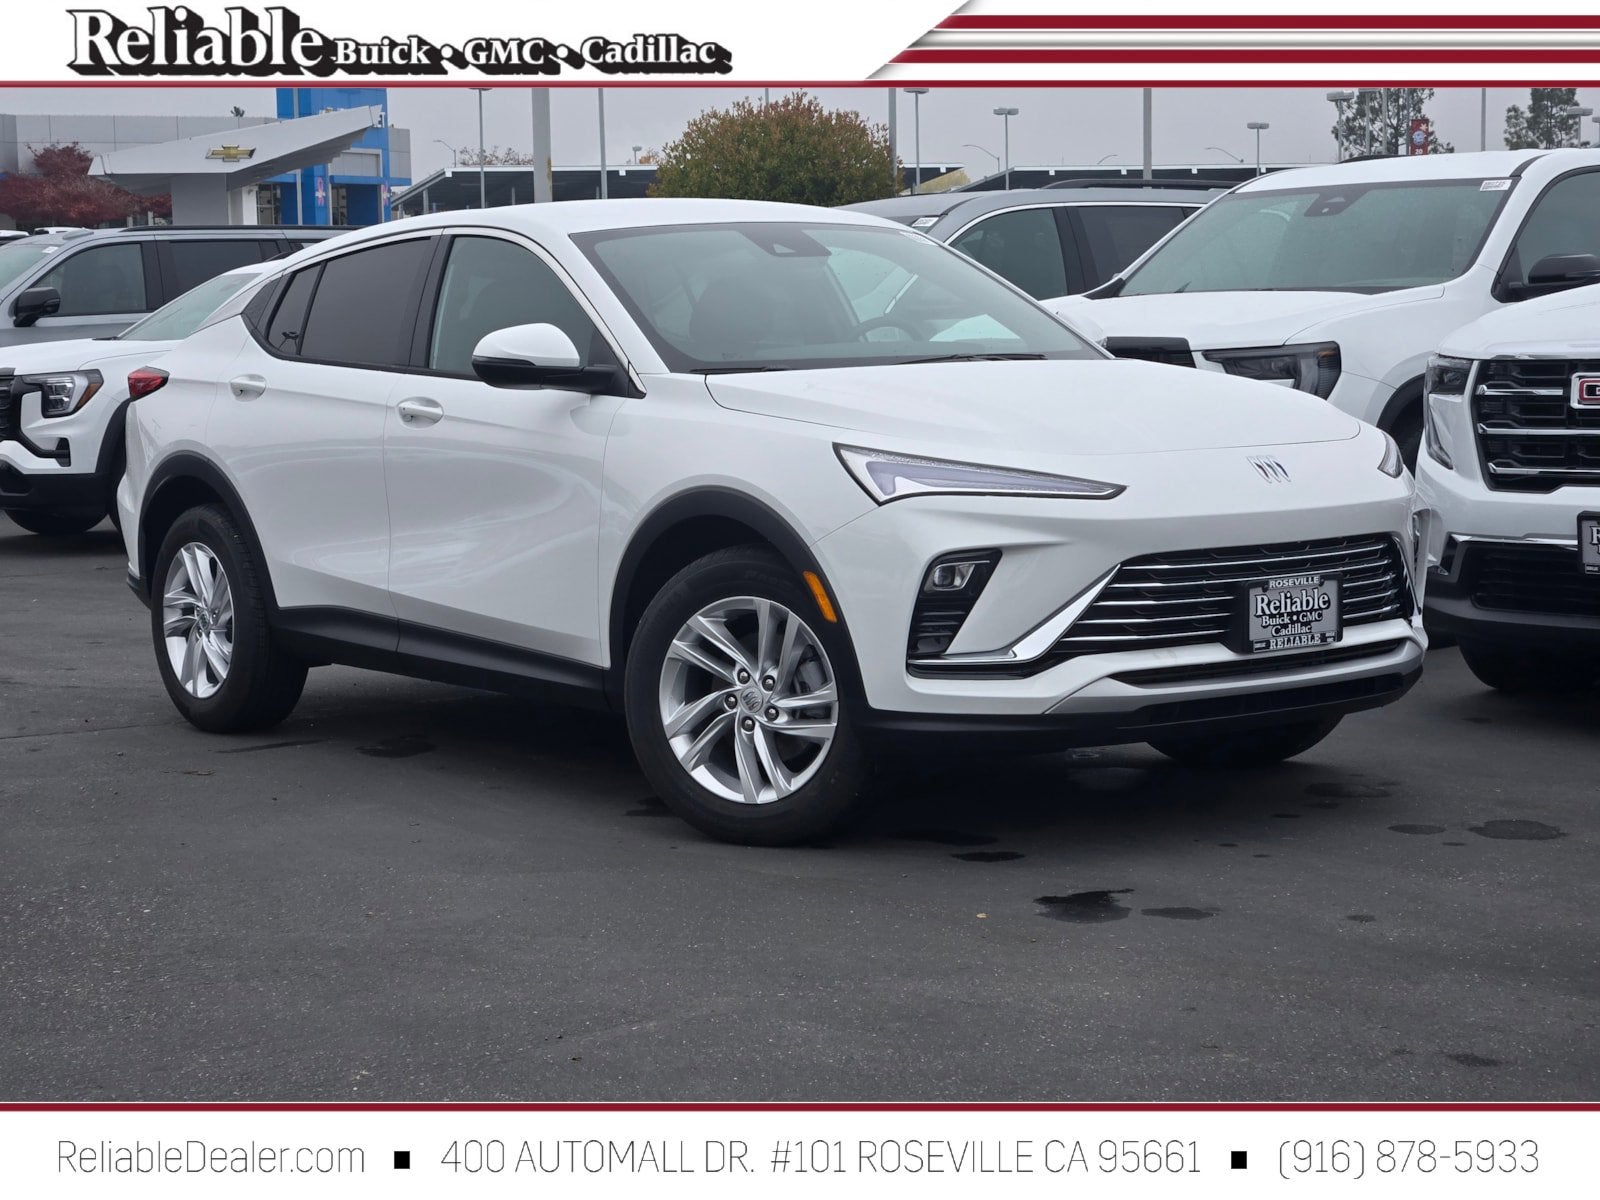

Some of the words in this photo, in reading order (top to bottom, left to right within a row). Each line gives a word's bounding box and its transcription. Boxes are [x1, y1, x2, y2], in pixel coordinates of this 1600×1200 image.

[1269, 576, 1320, 588] ROSEVILLE
[1255, 588, 1330, 616] Reliable
[1261, 612, 1291, 627] Buick
[1299, 610, 1323, 623] GMC
[1271, 624, 1312, 637] Cadillac
[1269, 633, 1321, 650] RELIABLE
